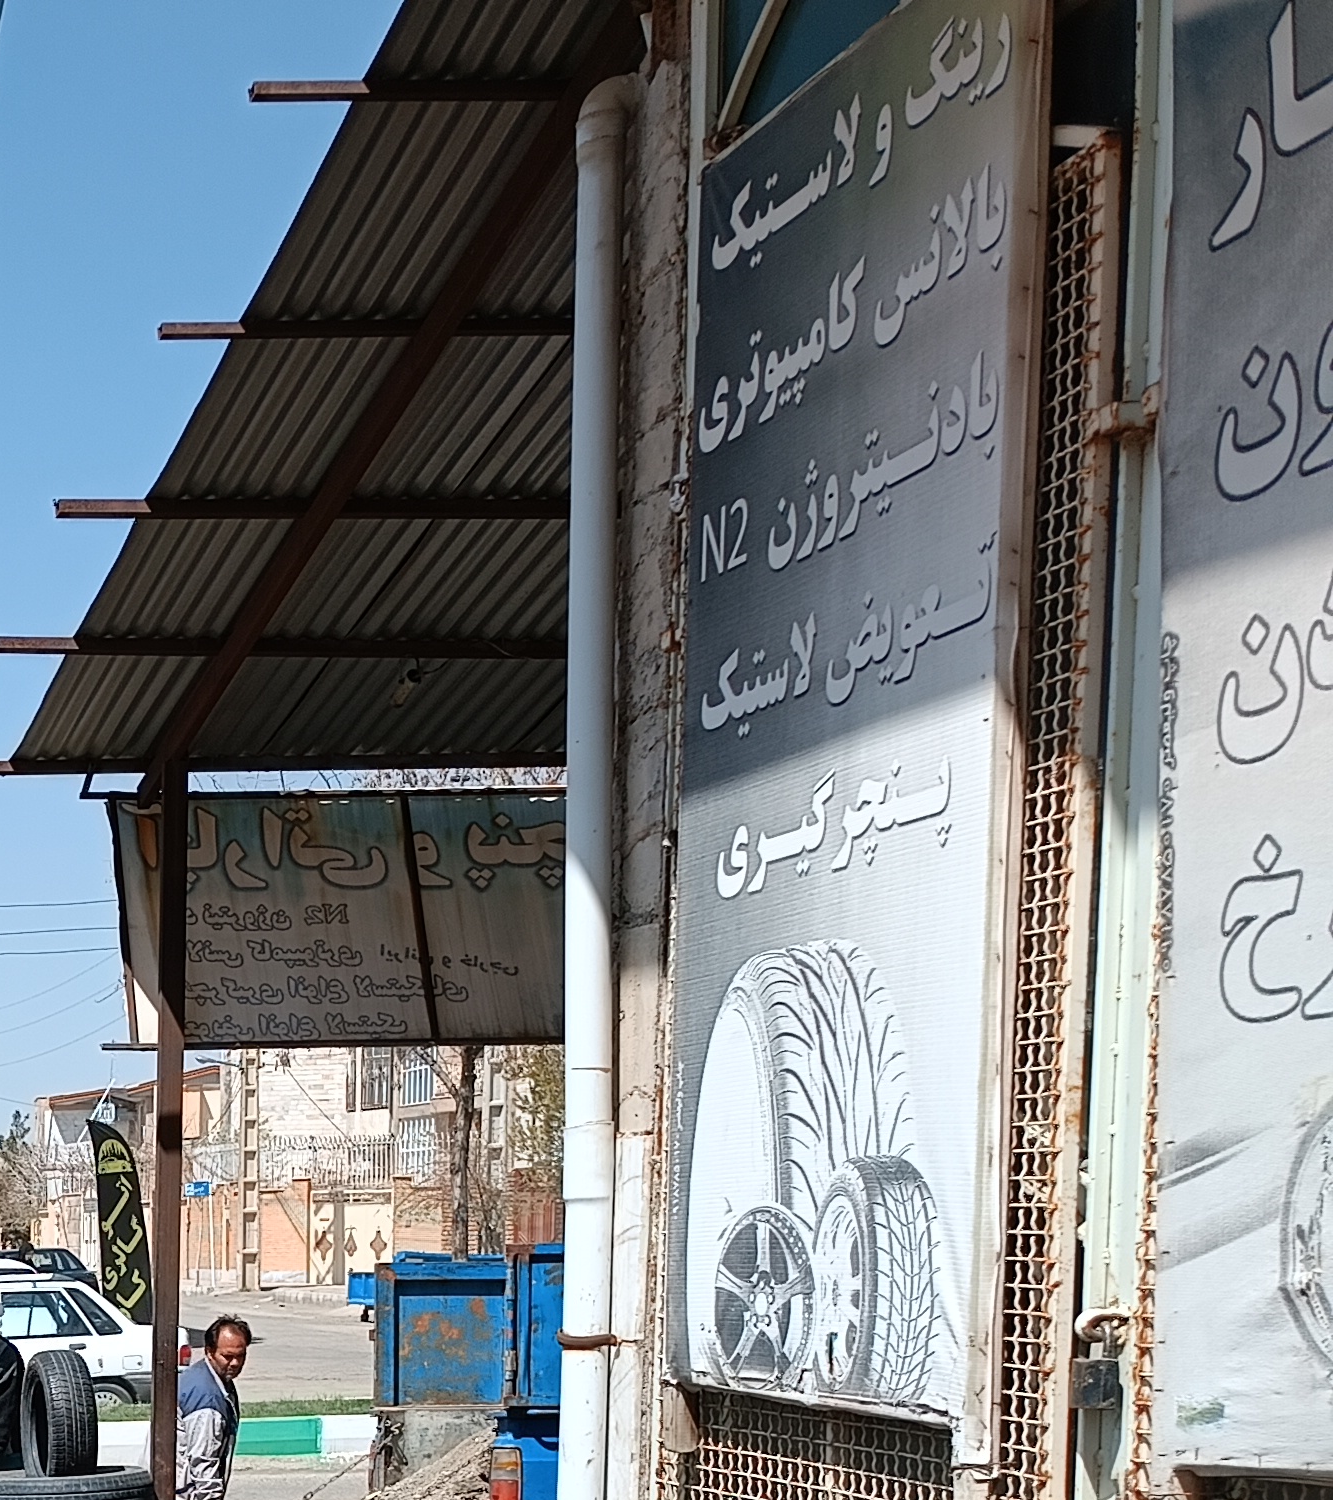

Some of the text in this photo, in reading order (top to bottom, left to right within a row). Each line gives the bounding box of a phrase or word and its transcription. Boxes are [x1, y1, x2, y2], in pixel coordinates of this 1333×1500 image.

[711, 12, 1014, 273] رینگ و لاستیک
[698, 161, 1009, 454] بالانس کامپیوتری
[699, 497, 749, 583] N2
[700, 530, 1000, 733] تعویض لاستیک
